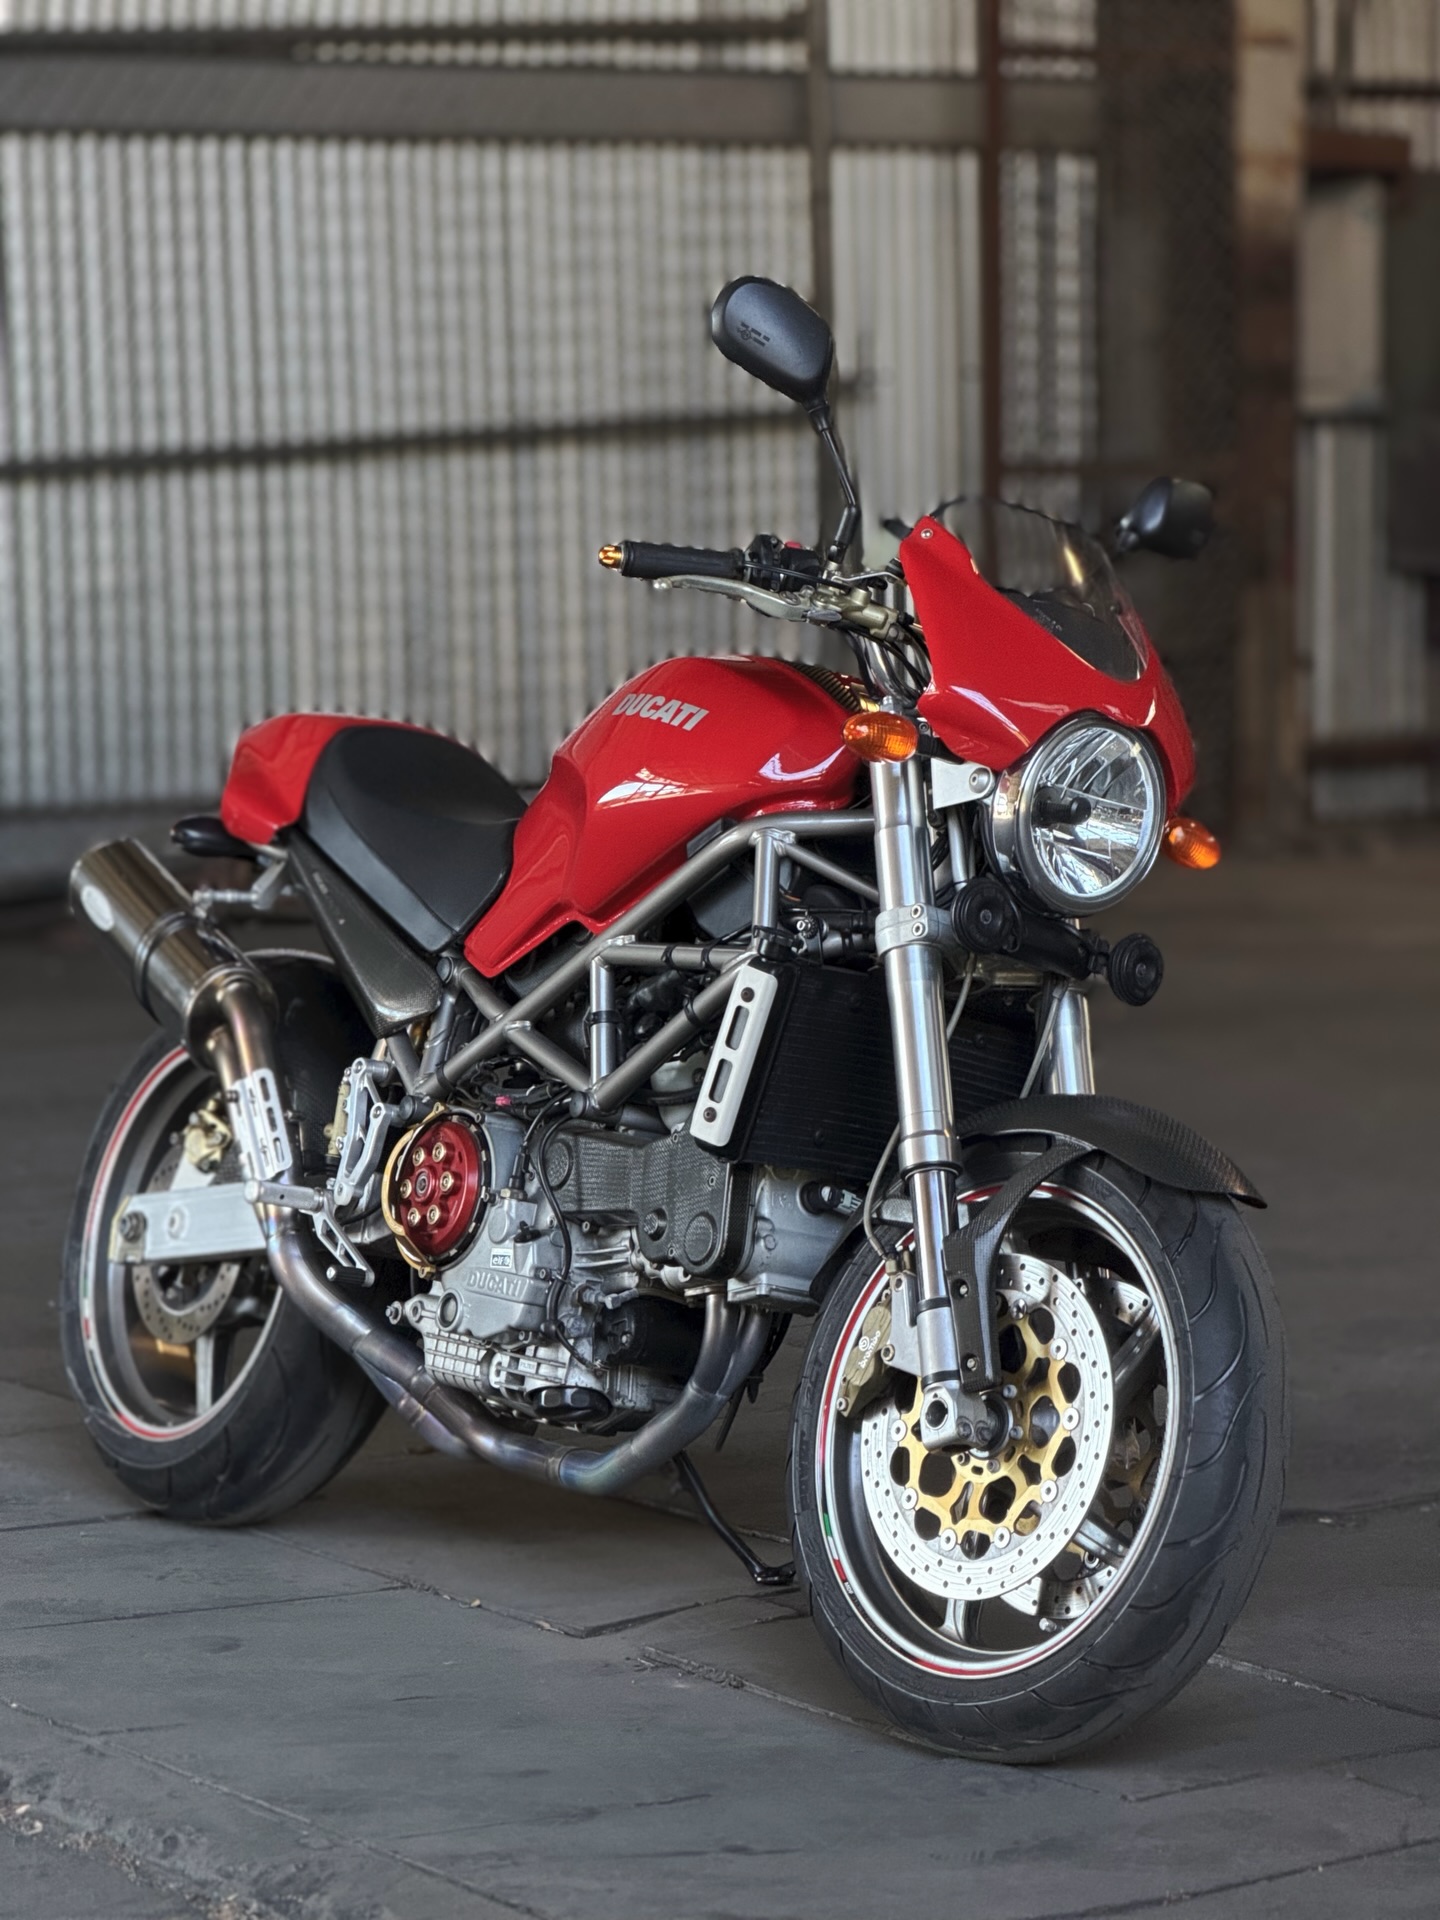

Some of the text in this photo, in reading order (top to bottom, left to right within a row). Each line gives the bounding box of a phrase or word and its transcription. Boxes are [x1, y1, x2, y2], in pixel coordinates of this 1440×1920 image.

[612, 693, 709, 731] DUCATI
[467, 1270, 522, 1297] DUCATI
[858, 1330, 881, 1369] brembo
